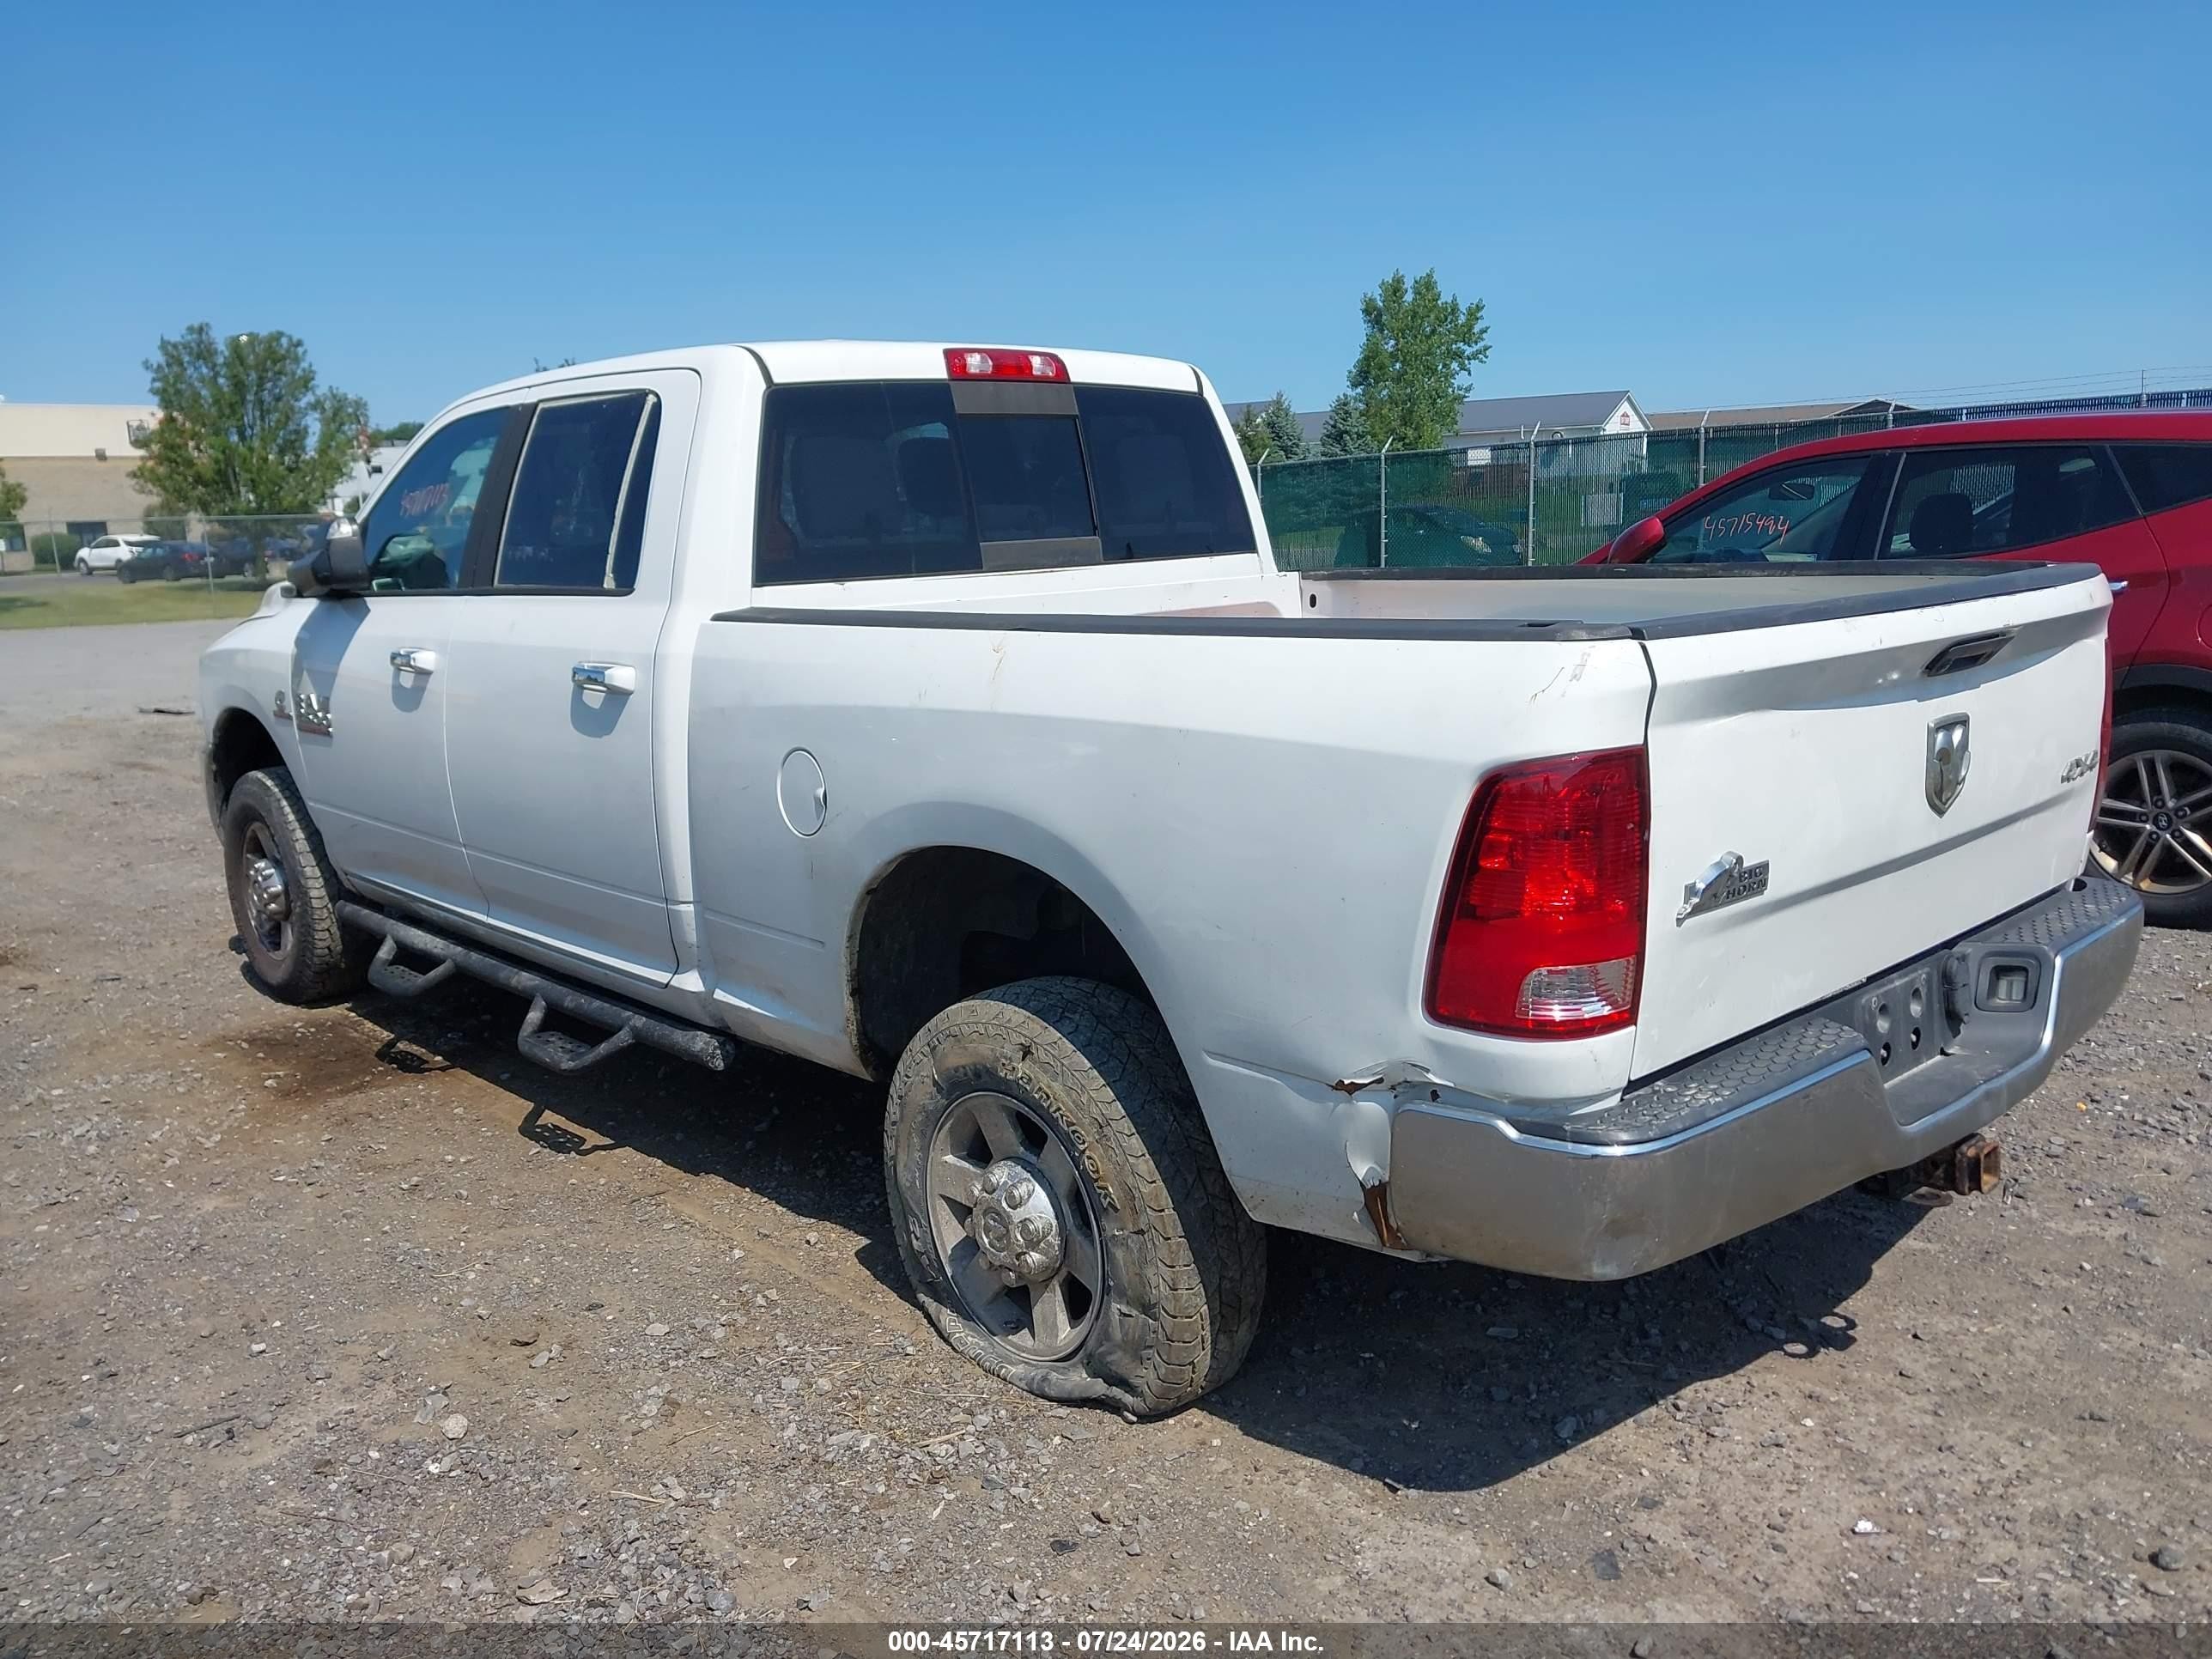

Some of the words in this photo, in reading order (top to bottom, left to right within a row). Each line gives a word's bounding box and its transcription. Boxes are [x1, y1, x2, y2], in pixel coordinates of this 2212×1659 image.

[1705, 513, 1790, 545] 45715494
[1738, 866, 1764, 884] BIG
[1725, 878, 1768, 900] HORN
